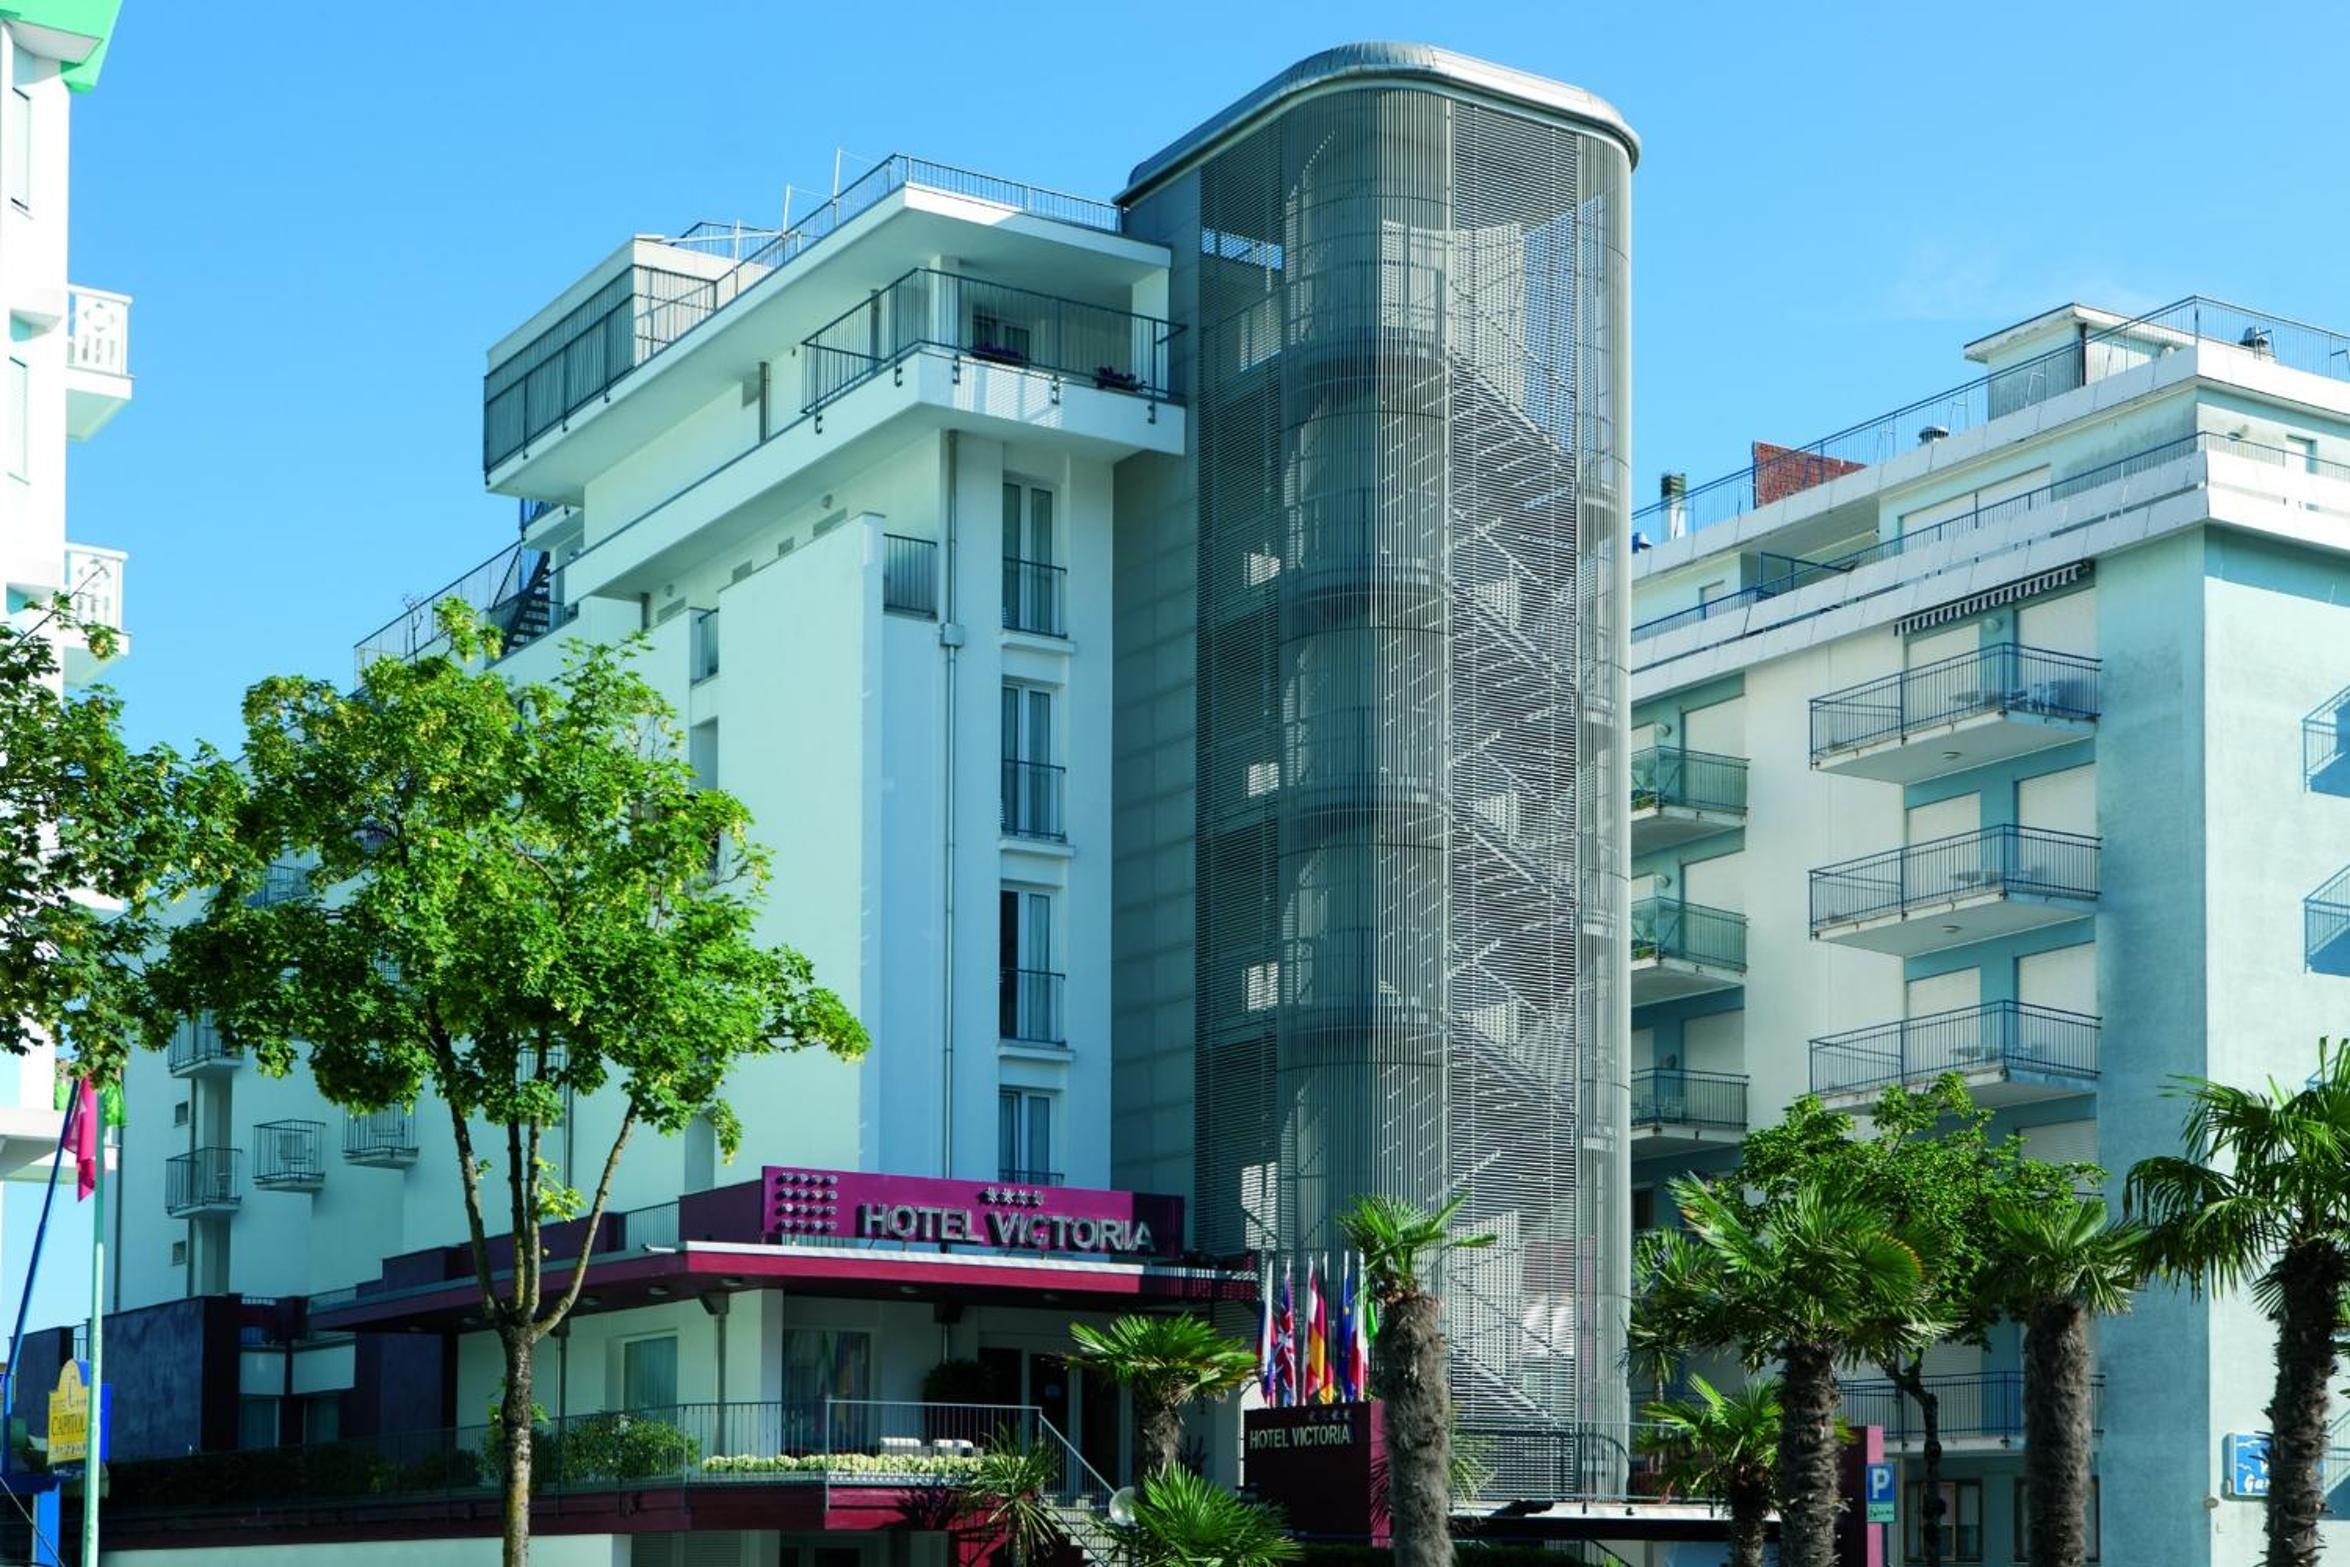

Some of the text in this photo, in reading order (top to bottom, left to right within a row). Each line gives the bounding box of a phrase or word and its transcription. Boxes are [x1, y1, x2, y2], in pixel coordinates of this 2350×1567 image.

[862, 1203, 1156, 1252] HOTEL VICTORIA
[1250, 1424, 1351, 1449] HOTEL VICTORIA
[1872, 1467, 1890, 1499] P
